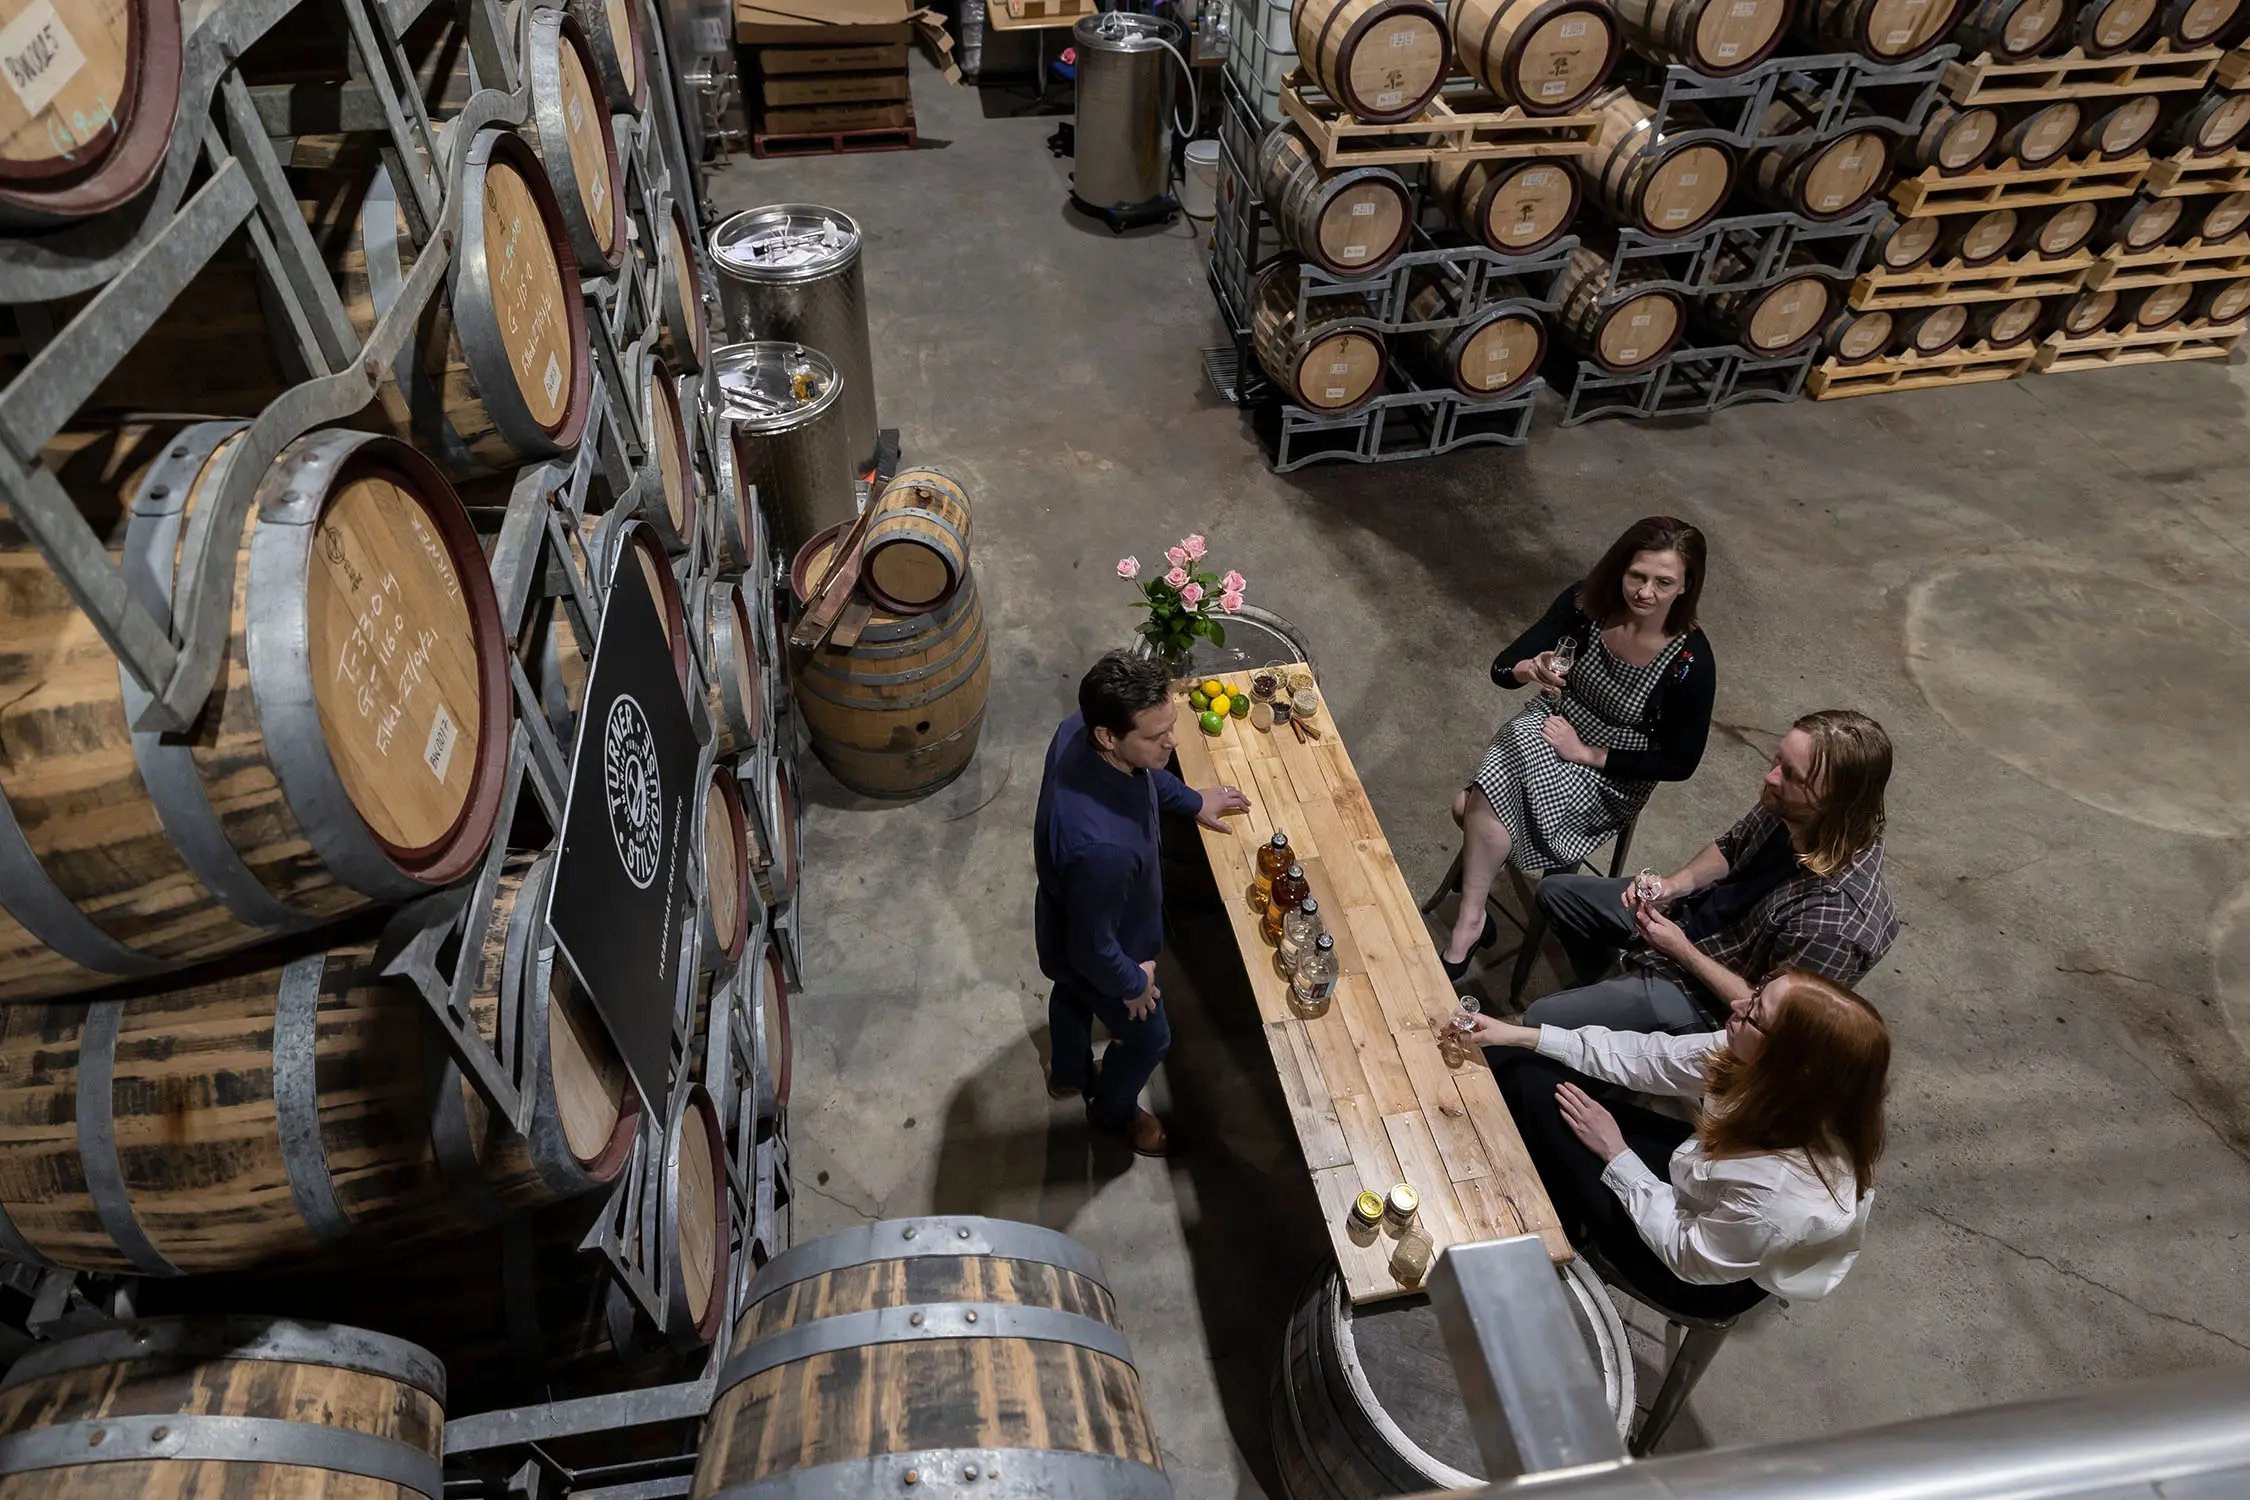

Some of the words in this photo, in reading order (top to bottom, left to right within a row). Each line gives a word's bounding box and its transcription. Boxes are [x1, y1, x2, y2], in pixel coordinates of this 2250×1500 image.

[411, 511, 459, 605] TURNER
[429, 718, 449, 770] BW0017
[608, 703, 634, 815] TURNER
[627, 731, 660, 878] STILLHOUSE
[659, 894, 672, 981] TASMANIAN
[668, 847, 677, 894] CRAFT
[673, 795, 683, 848] SPIRITS
